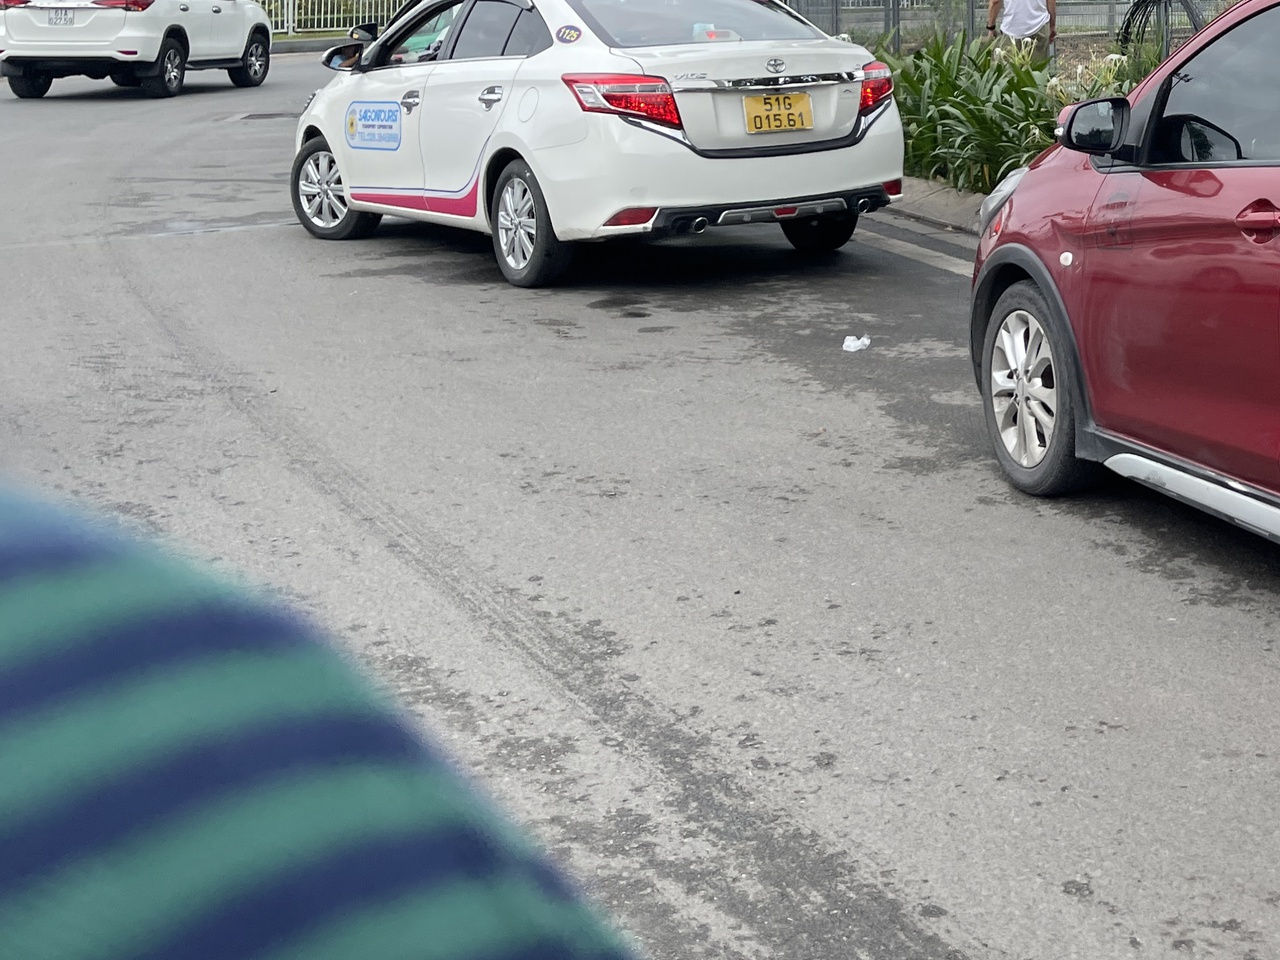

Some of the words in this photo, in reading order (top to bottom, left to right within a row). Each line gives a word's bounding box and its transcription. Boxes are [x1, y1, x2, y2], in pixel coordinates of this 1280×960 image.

[559, 27, 580, 41] 1125
[763, 95, 793, 112] 51G
[753, 112, 805, 130] 015.61
